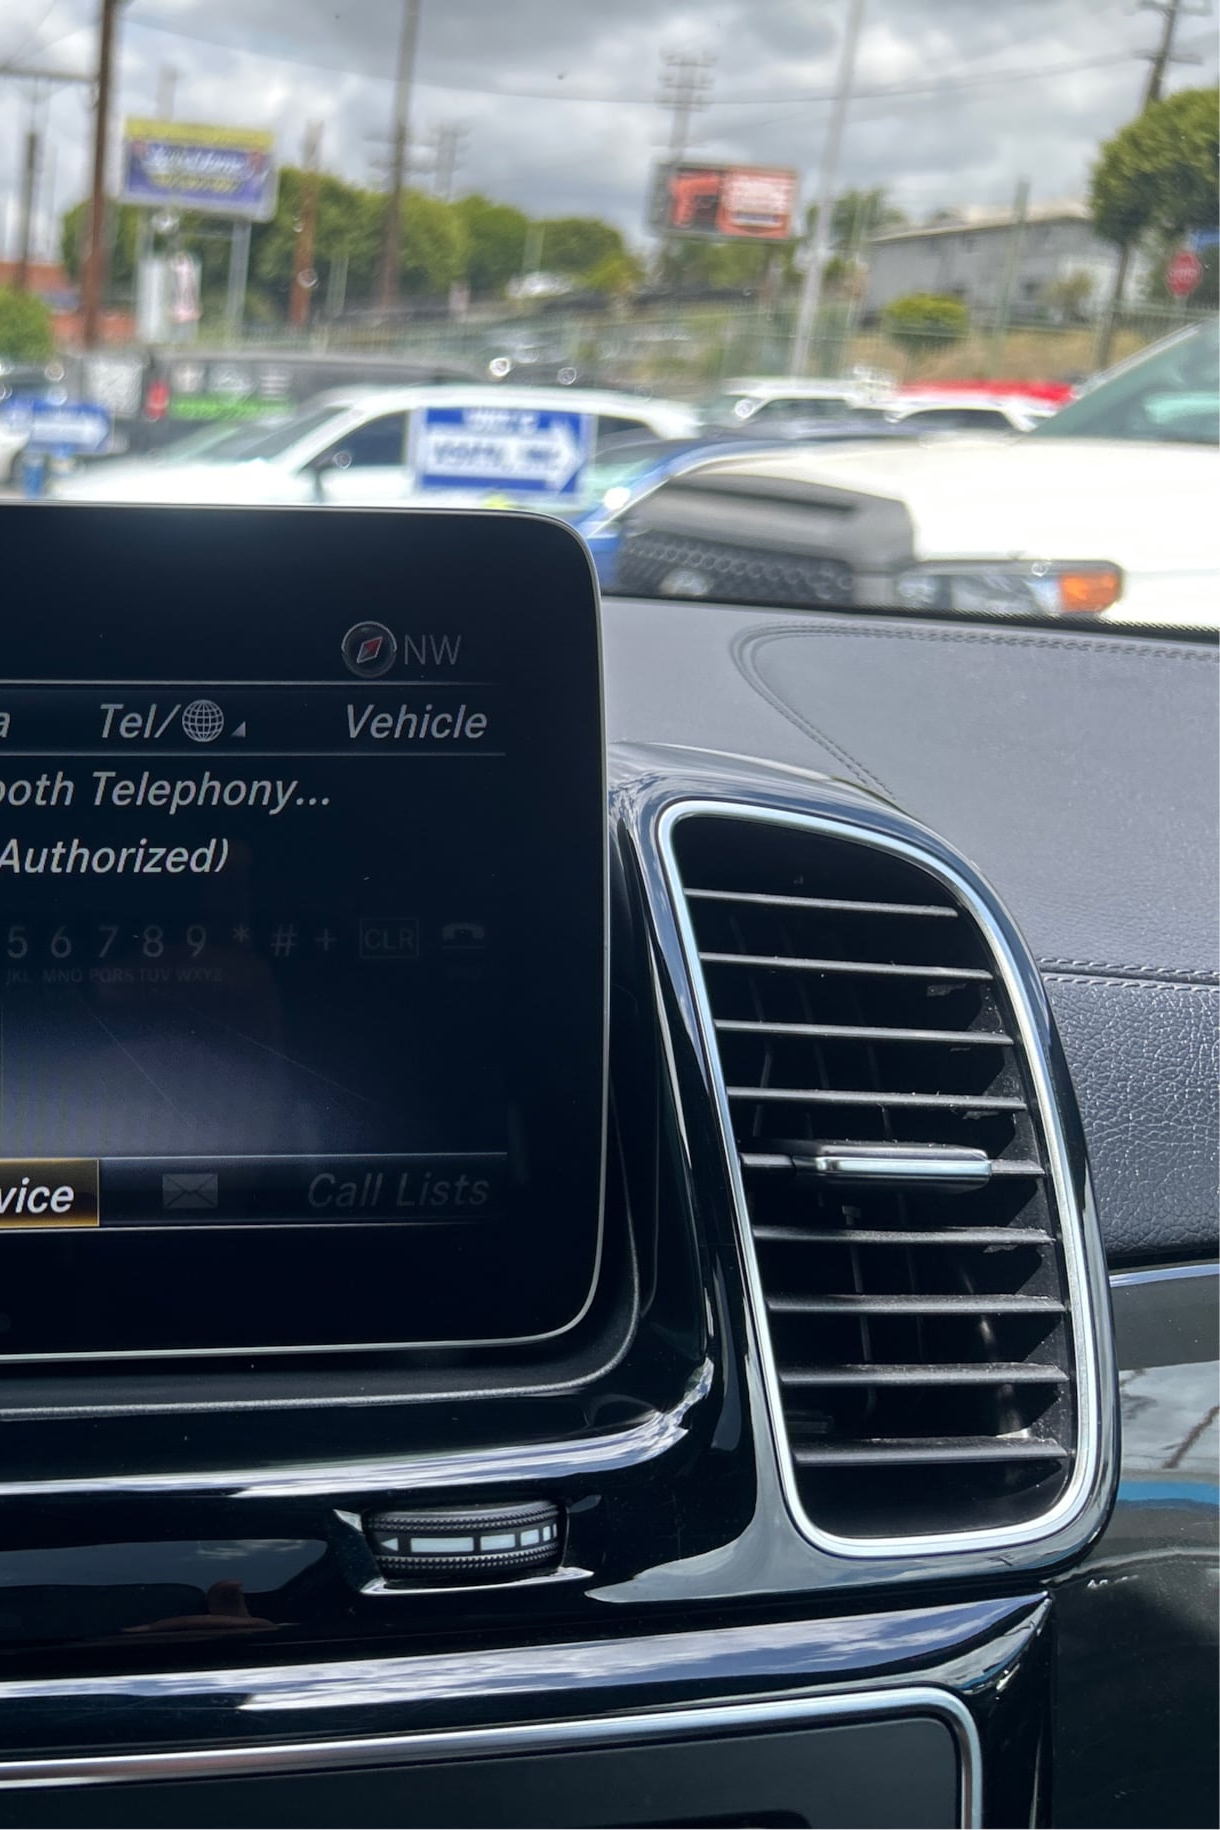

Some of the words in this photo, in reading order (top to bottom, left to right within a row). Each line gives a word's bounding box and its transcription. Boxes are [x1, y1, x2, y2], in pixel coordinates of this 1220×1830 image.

[402, 634, 462, 665] NW
[344, 703, 489, 740] Vehicle
[90, 771, 331, 815] Telephony...
[363, 927, 414, 951] CLR
[42, 967, 83, 984] MNO
[89, 967, 134, 984] PQRS
[139, 967, 171, 984] TUV
[307, 1171, 385, 1209] Call
[395, 1170, 492, 1207] Lists
